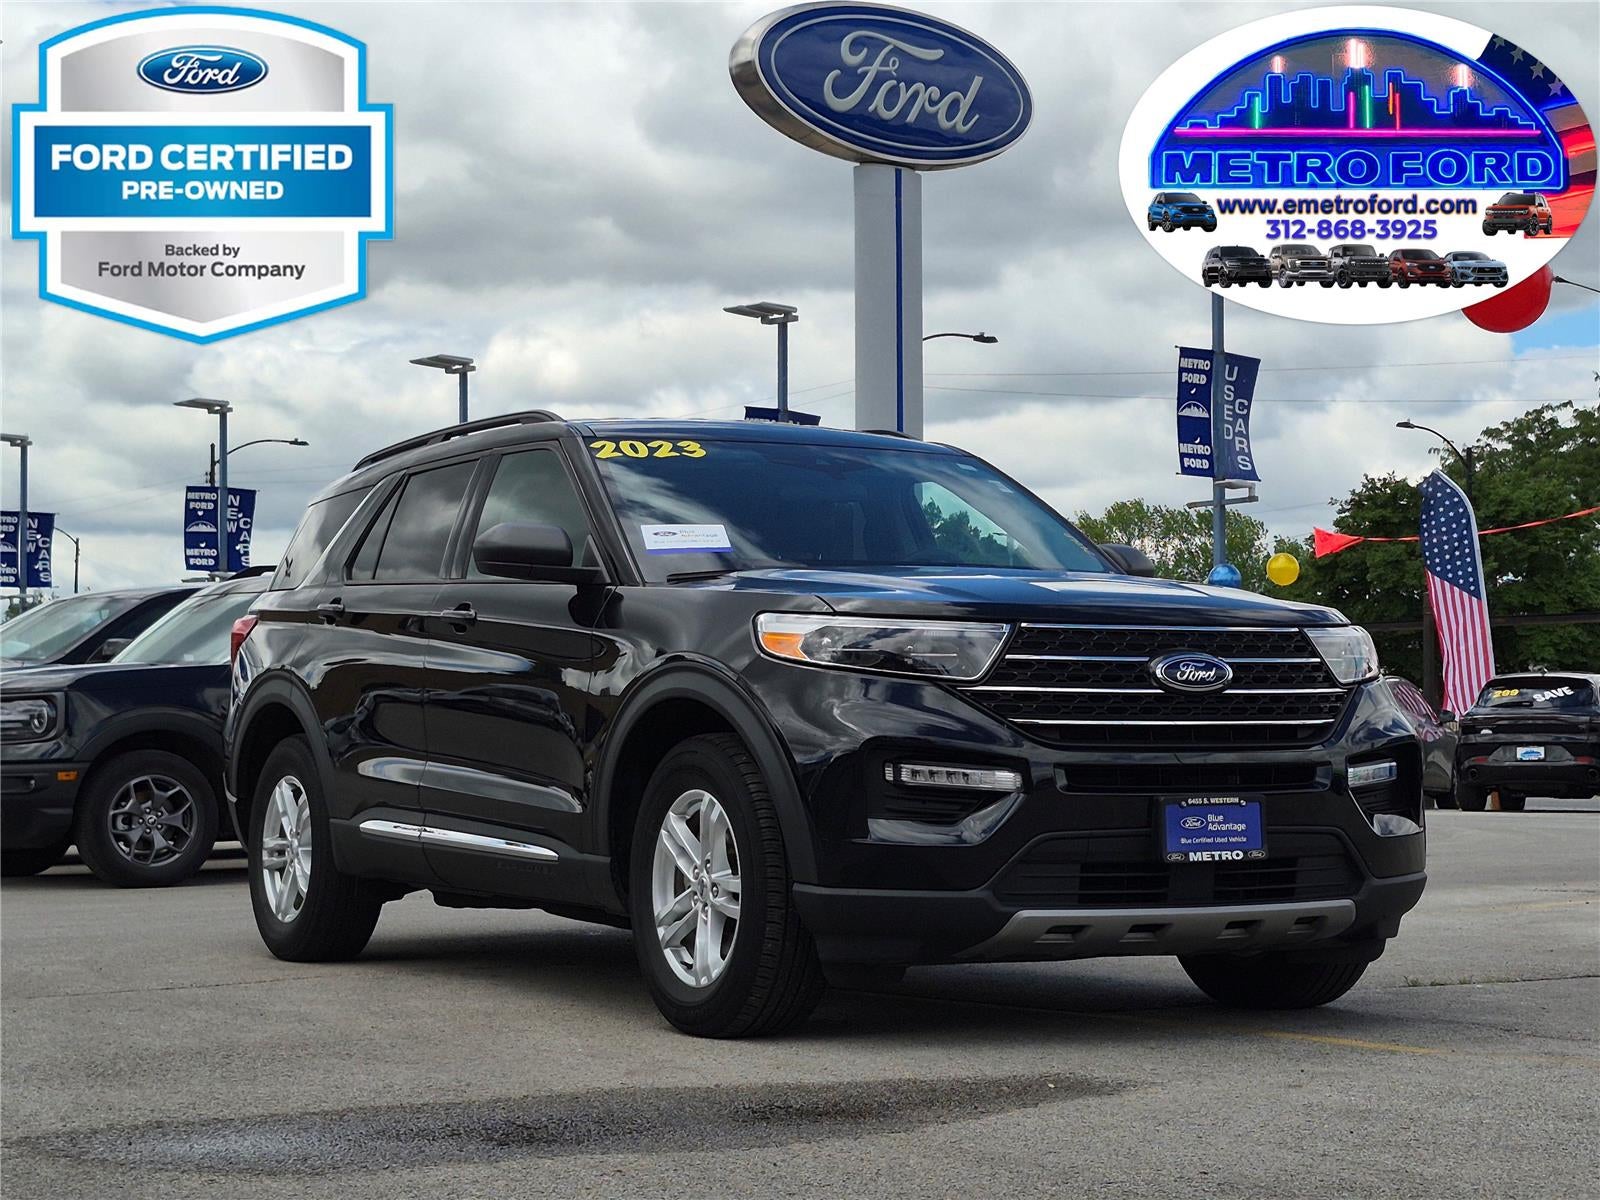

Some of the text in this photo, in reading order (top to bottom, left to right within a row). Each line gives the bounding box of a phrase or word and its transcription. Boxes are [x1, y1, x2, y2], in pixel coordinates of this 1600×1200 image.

[824, 30, 983, 134] Ford
[1179, 357, 1211, 371] METRO
[1181, 372, 1207, 385] FORD
[1223, 364, 1238, 440] USED
[1234, 398, 1252, 471] CARS
[589, 440, 707, 459] 2023
[1179, 443, 1211, 456] METRO
[1183, 457, 1210, 470] FORD
[187, 491, 217, 500] METRO
[189, 501, 215, 510] FORD
[0, 516, 18, 524] TRO
[226, 494, 240, 533] NEW
[26, 518, 38, 553] NEW
[186, 548, 217, 557] METRO
[38, 537, 52, 582] CARS
[189, 558, 215, 566] FORD
[0, 567, 17, 575] TRO
[1177, 661, 1217, 682] Ford
[1532, 686, 1575, 702] SAVE
[1207, 814, 1224, 822] Blue
[1207, 822, 1247, 831] Advantage
[1188, 850, 1244, 862] METRO
